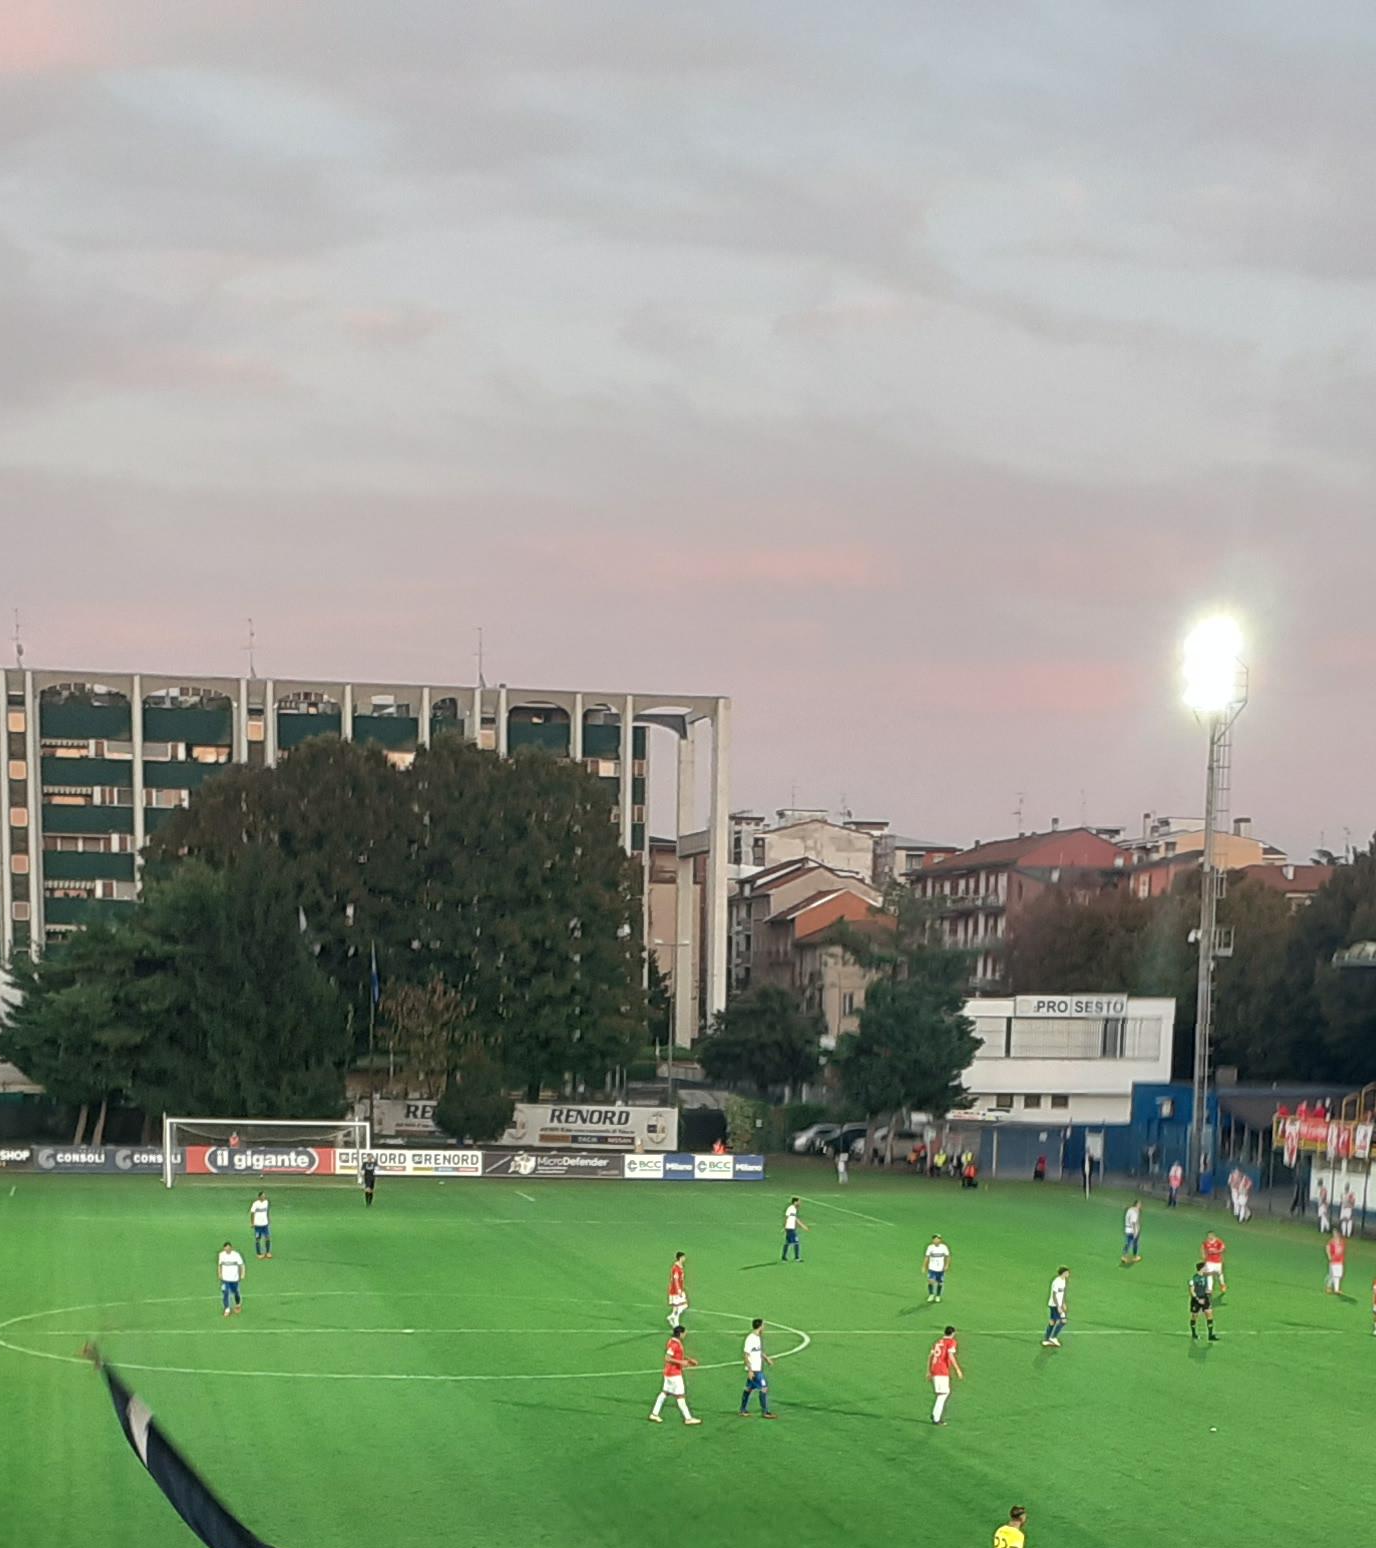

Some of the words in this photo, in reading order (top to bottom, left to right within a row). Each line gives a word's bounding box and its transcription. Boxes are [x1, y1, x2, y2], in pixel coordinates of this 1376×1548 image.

[1036, 1000, 1069, 1013] PRO
[1074, 1000, 1124, 1014] SESTO
[549, 1108, 631, 1126] RENORD
[56, 1153, 105, 1163] CONSOLI
[133, 1153, 182, 1164] CONSLI
[217, 1150, 229, 1167] il
[233, 1150, 310, 1170] gigante
[424, 1153, 479, 1166] RENORD
[639, 1160, 662, 1169] BCC
[708, 1161, 731, 1170] BCC
